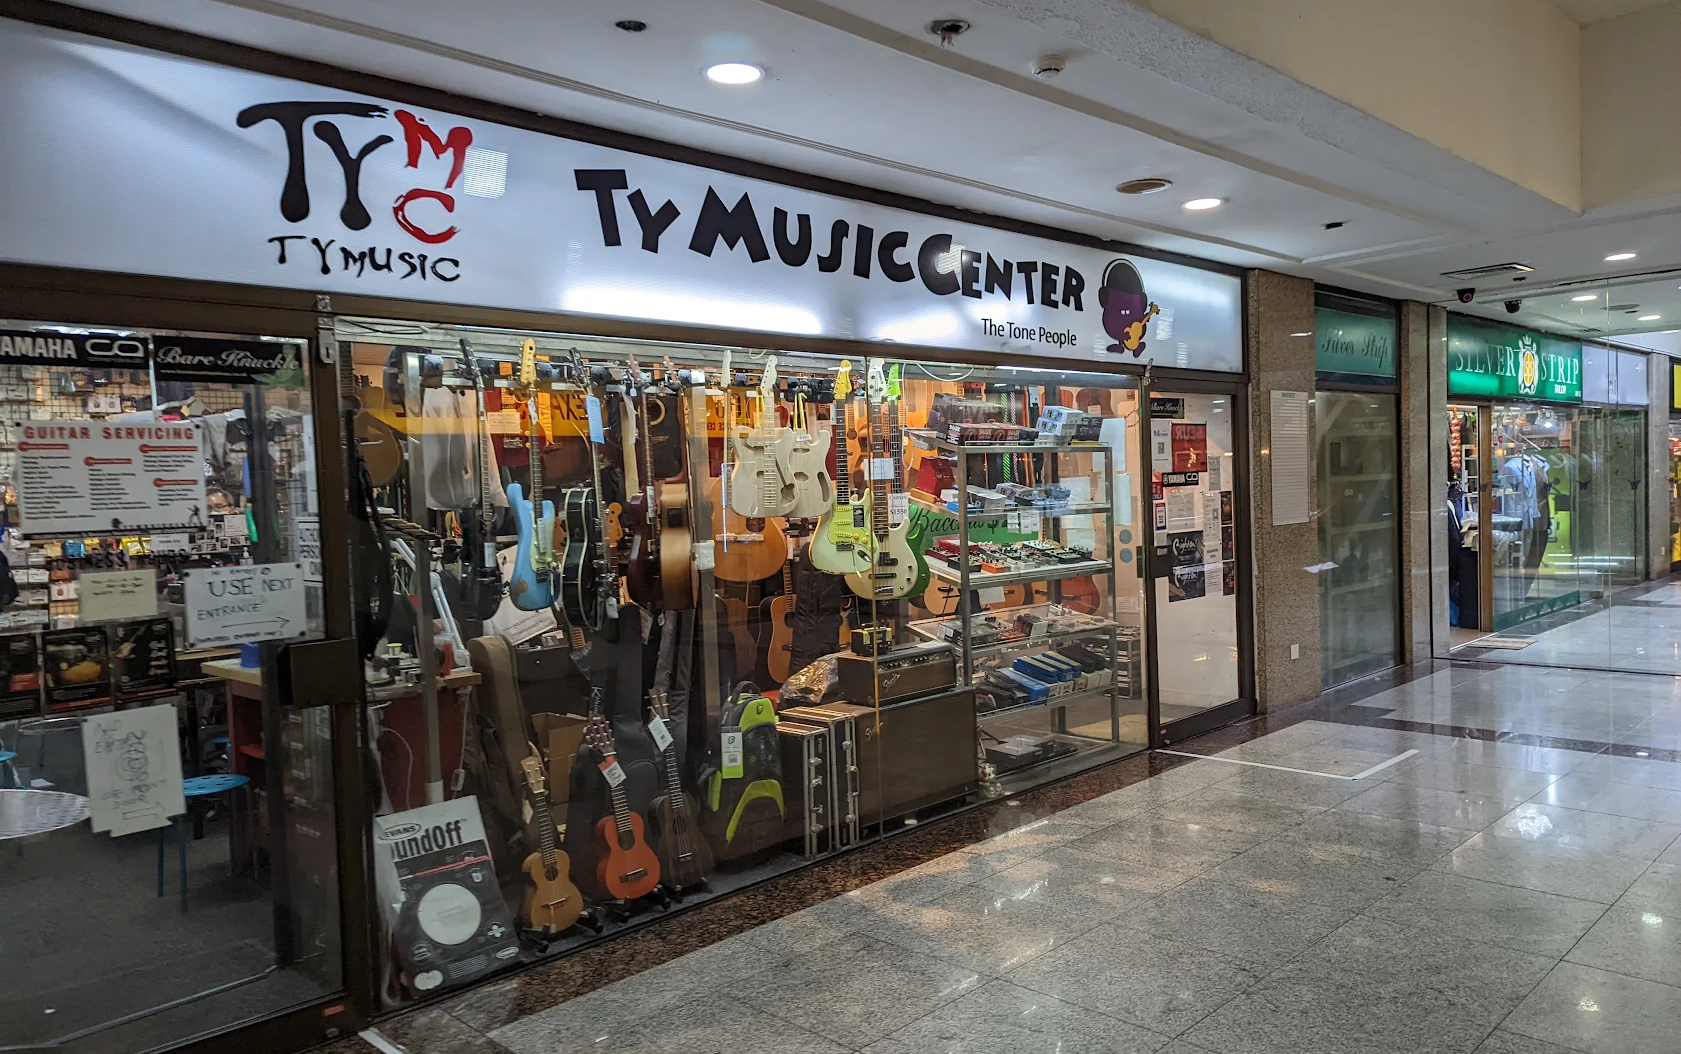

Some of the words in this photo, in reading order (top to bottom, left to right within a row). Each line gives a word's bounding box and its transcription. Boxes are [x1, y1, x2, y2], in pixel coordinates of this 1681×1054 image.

[981, 318, 1004, 338] The
[1006, 321, 1037, 342] Tone
[1038, 324, 1078, 347] People
[156, 345, 215, 366] Bare
[1455, 344, 1517, 377] SILVER
[1541, 353, 1579, 385] STRIP
[1554, 384, 1567, 395] TAILOR
[23, 426, 91, 439] GUITAR
[102, 427, 194, 440] SERVICING
[206, 577, 254, 597] USE
[261, 578, 294, 592] NEXT
[196, 603, 261, 621] ENTRANCE
